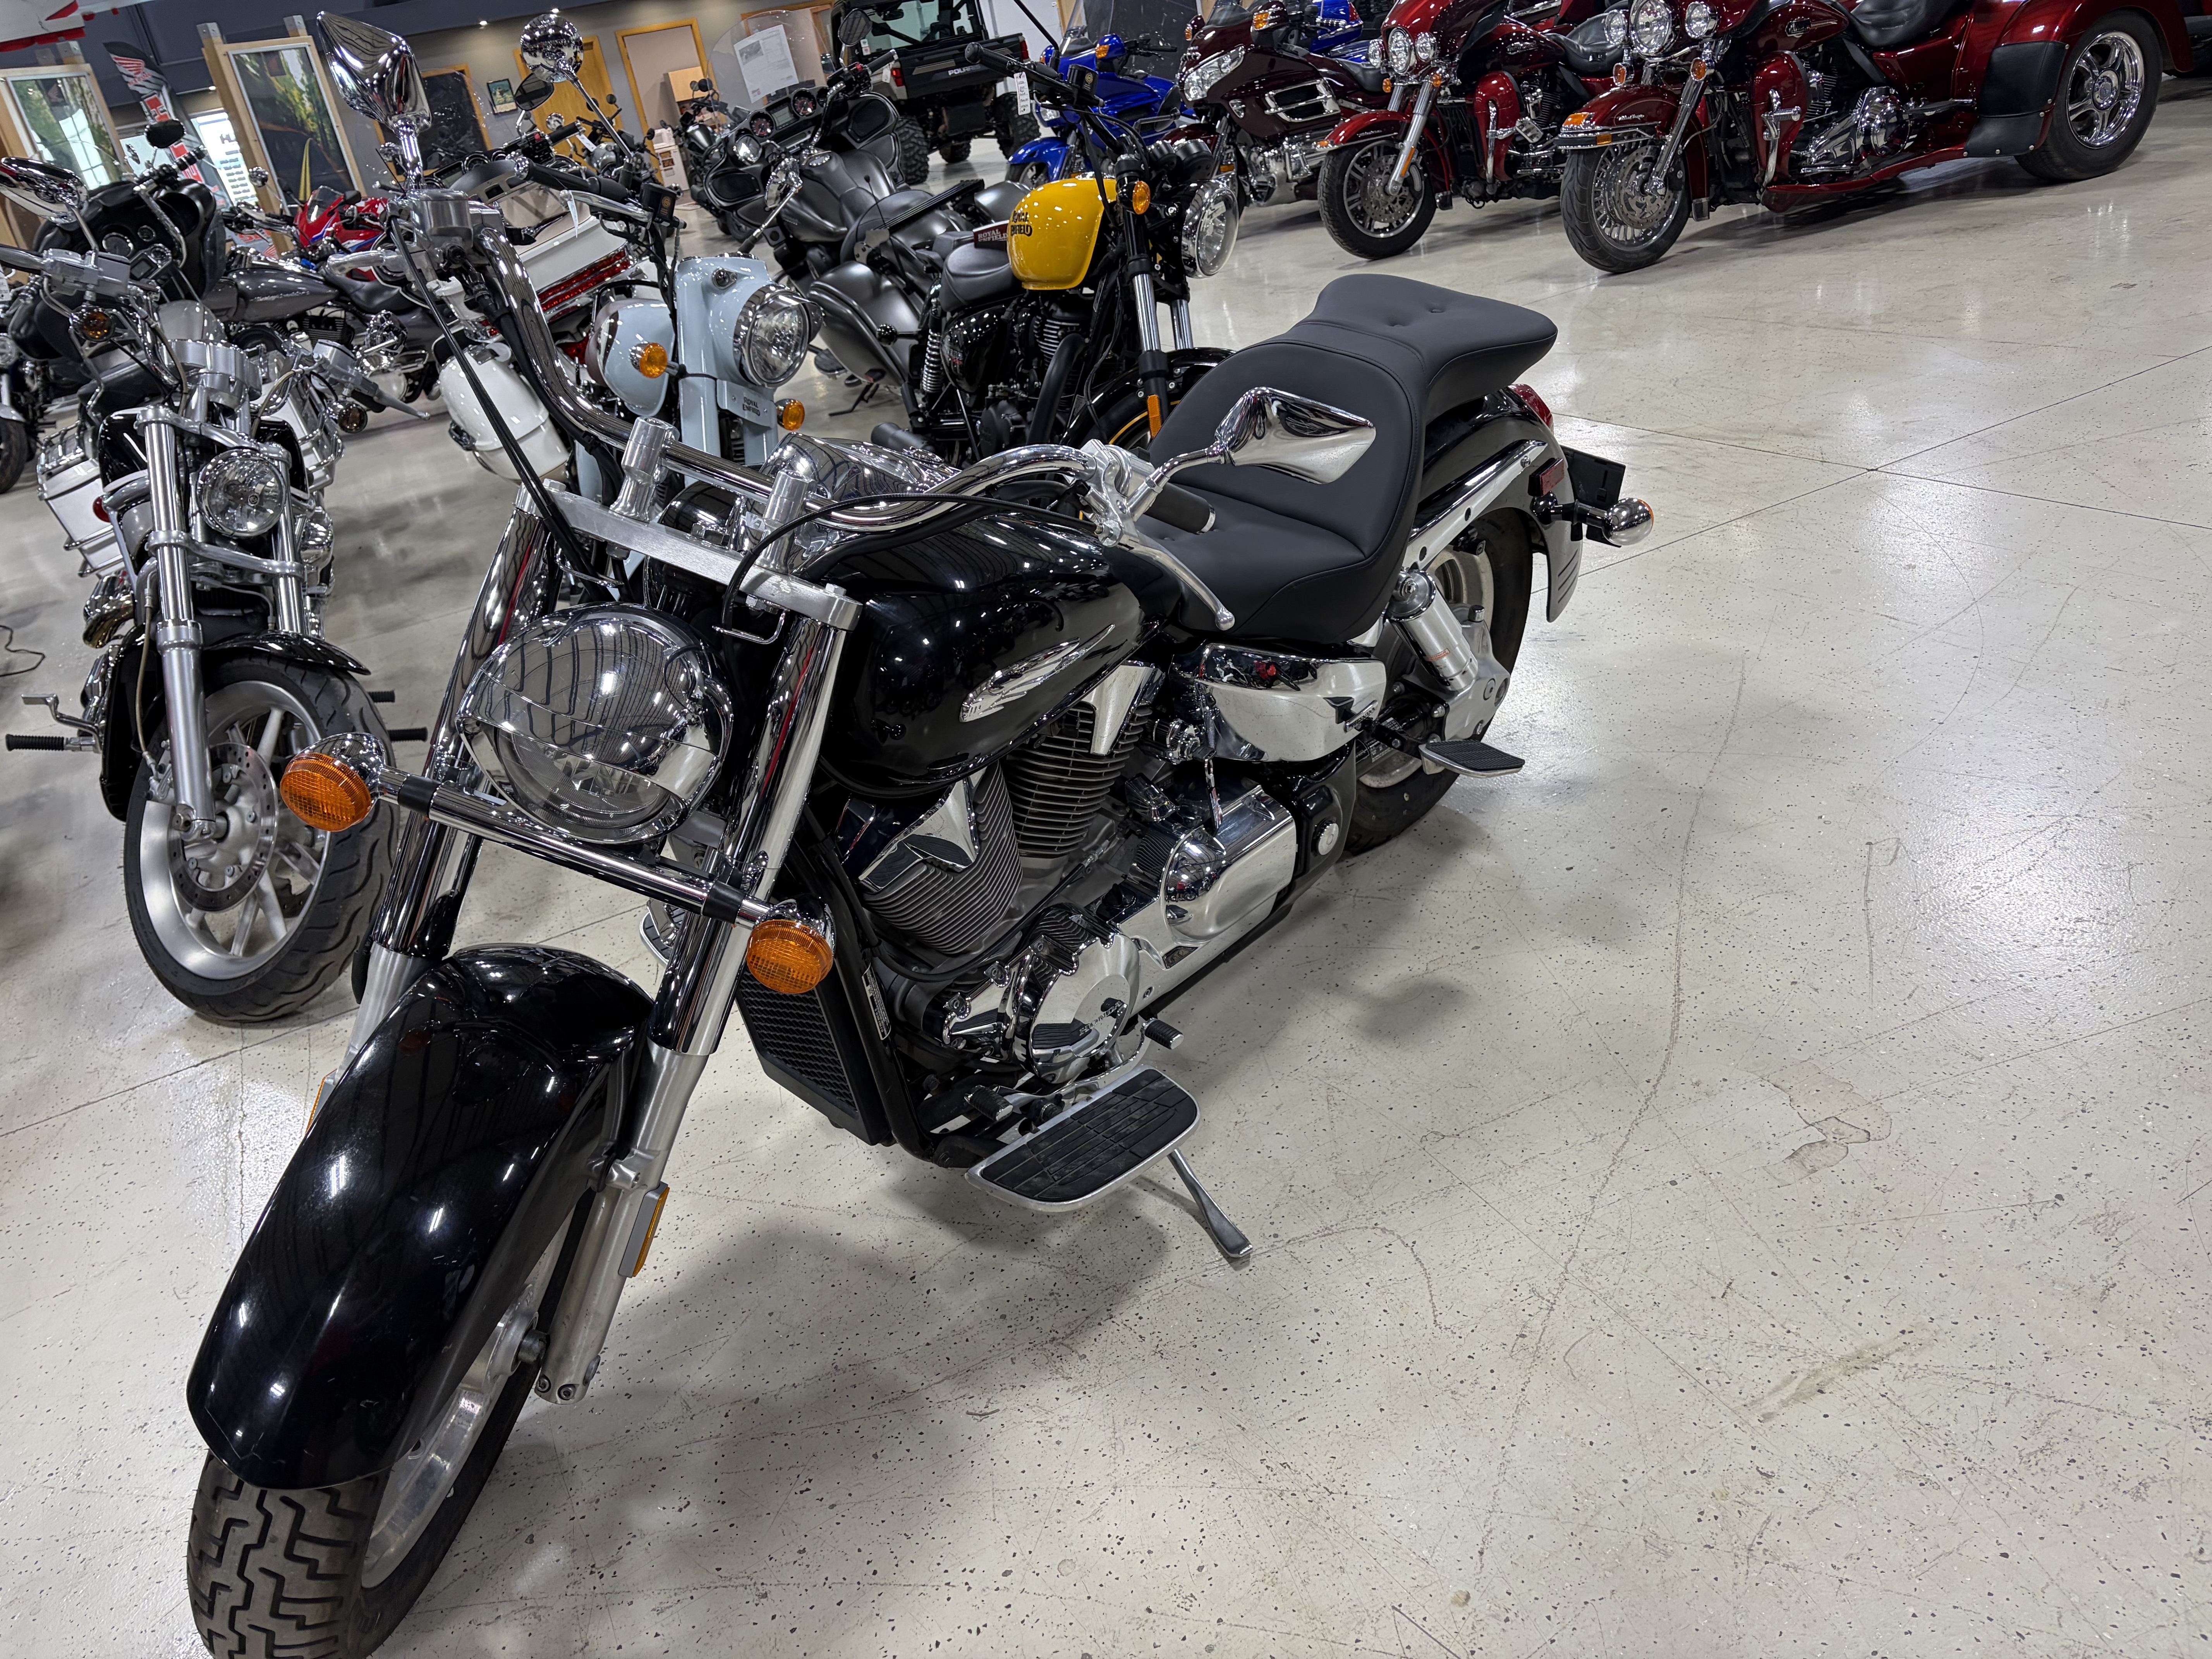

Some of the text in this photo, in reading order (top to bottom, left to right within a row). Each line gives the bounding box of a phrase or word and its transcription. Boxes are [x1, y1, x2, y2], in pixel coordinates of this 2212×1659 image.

[978, 229, 1001, 239] ROYAL
[744, 397, 759, 408] ROYAL
[743, 404, 760, 416] ENFIELD
[1079, 1000, 1123, 1036] HONDA
